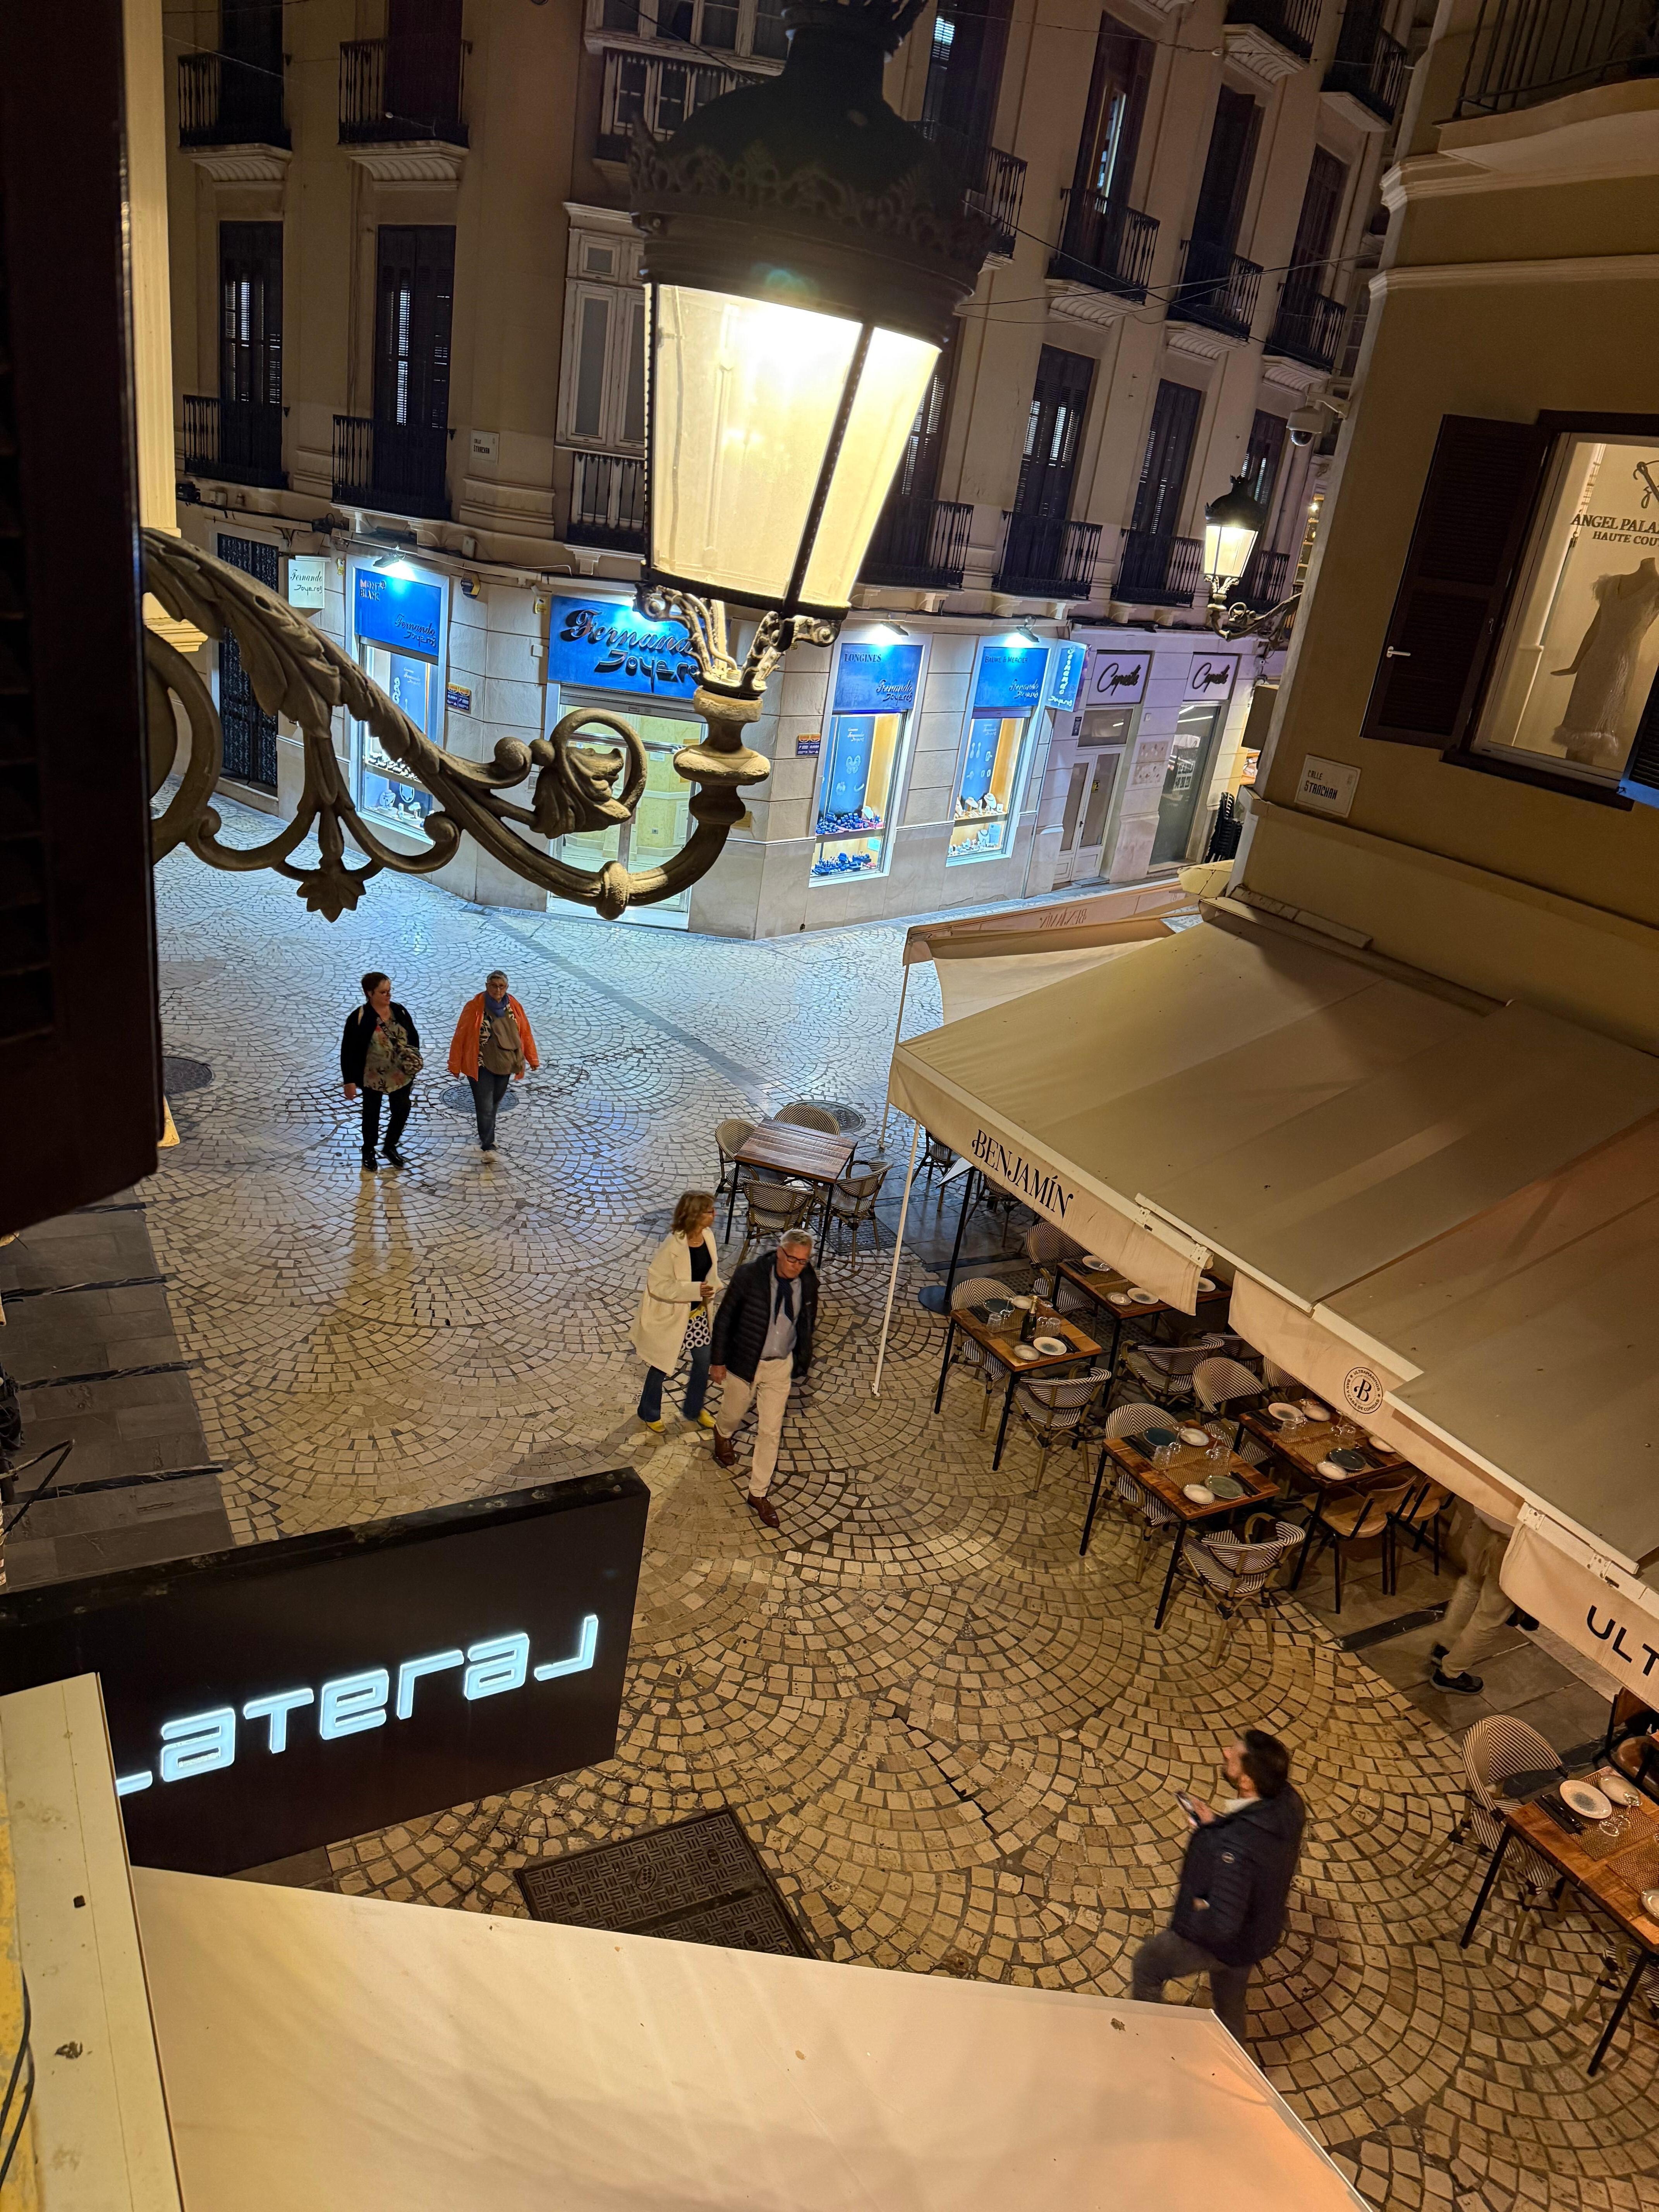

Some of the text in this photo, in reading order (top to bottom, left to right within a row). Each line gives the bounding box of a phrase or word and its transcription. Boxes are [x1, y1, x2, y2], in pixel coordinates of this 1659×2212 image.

[1570, 509, 1619, 529] ÁNGEL
[1592, 531, 1632, 543] HAUTE
[290, 568, 322, 582] Fernando
[294, 585, 323, 596] Joyeros
[395, 613, 436, 636] Fernando
[404, 631, 436, 648] Joyeros
[844, 654, 881, 662] LONGINES
[876, 679, 913, 693] Fernando
[883, 693, 913, 706] Joyeros
[1308, 770, 1323, 780] CALLE
[1304, 780, 1338, 800] STRACHAN
[972, 1128, 1073, 1219] BENJAMÍN
[1353, 1379, 1372, 1402] B
